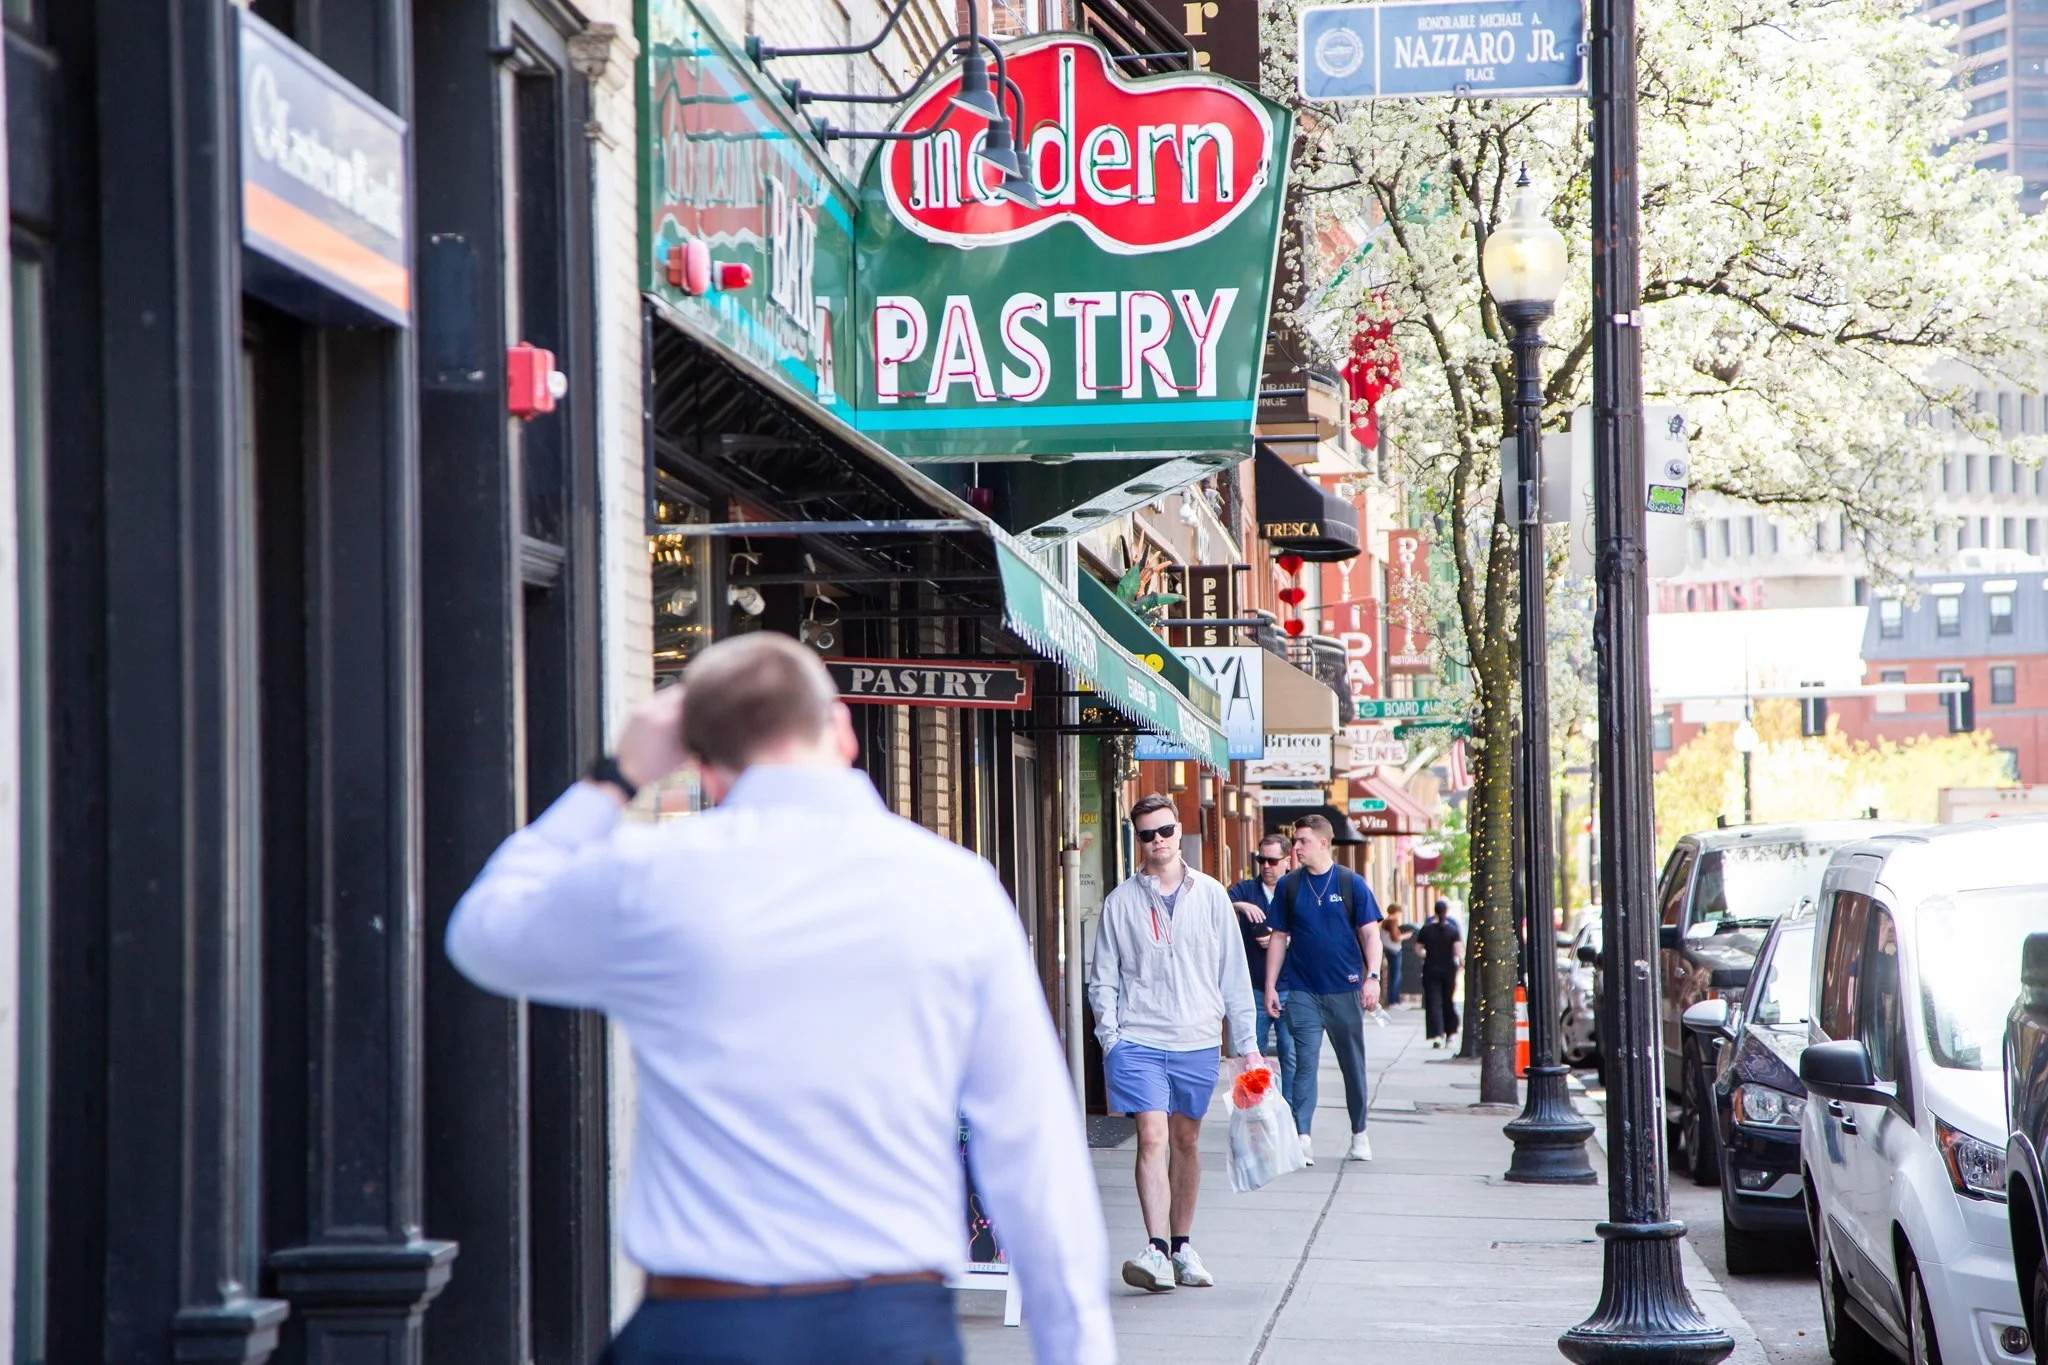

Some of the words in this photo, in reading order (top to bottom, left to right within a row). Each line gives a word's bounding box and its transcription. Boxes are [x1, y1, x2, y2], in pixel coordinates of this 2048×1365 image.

[1418, 15, 1475, 31] HONORABLE
[1479, 12, 1523, 28] MICHAEL
[1531, 13, 1543, 26] A.
[1394, 30, 1515, 69] NAZZARO
[1526, 29, 1565, 63] JR.
[1465, 67, 1496, 82] PLACE
[875, 287, 1240, 404] PASTRY
[1264, 522, 1320, 537] TRESCA
[850, 667, 992, 697] PASTRY
[1384, 701, 1419, 716] BOARD
[1265, 734, 1321, 748] Bricco
[1230, 745, 1254, 753] LOOR
[1361, 815, 1388, 829] Vita
